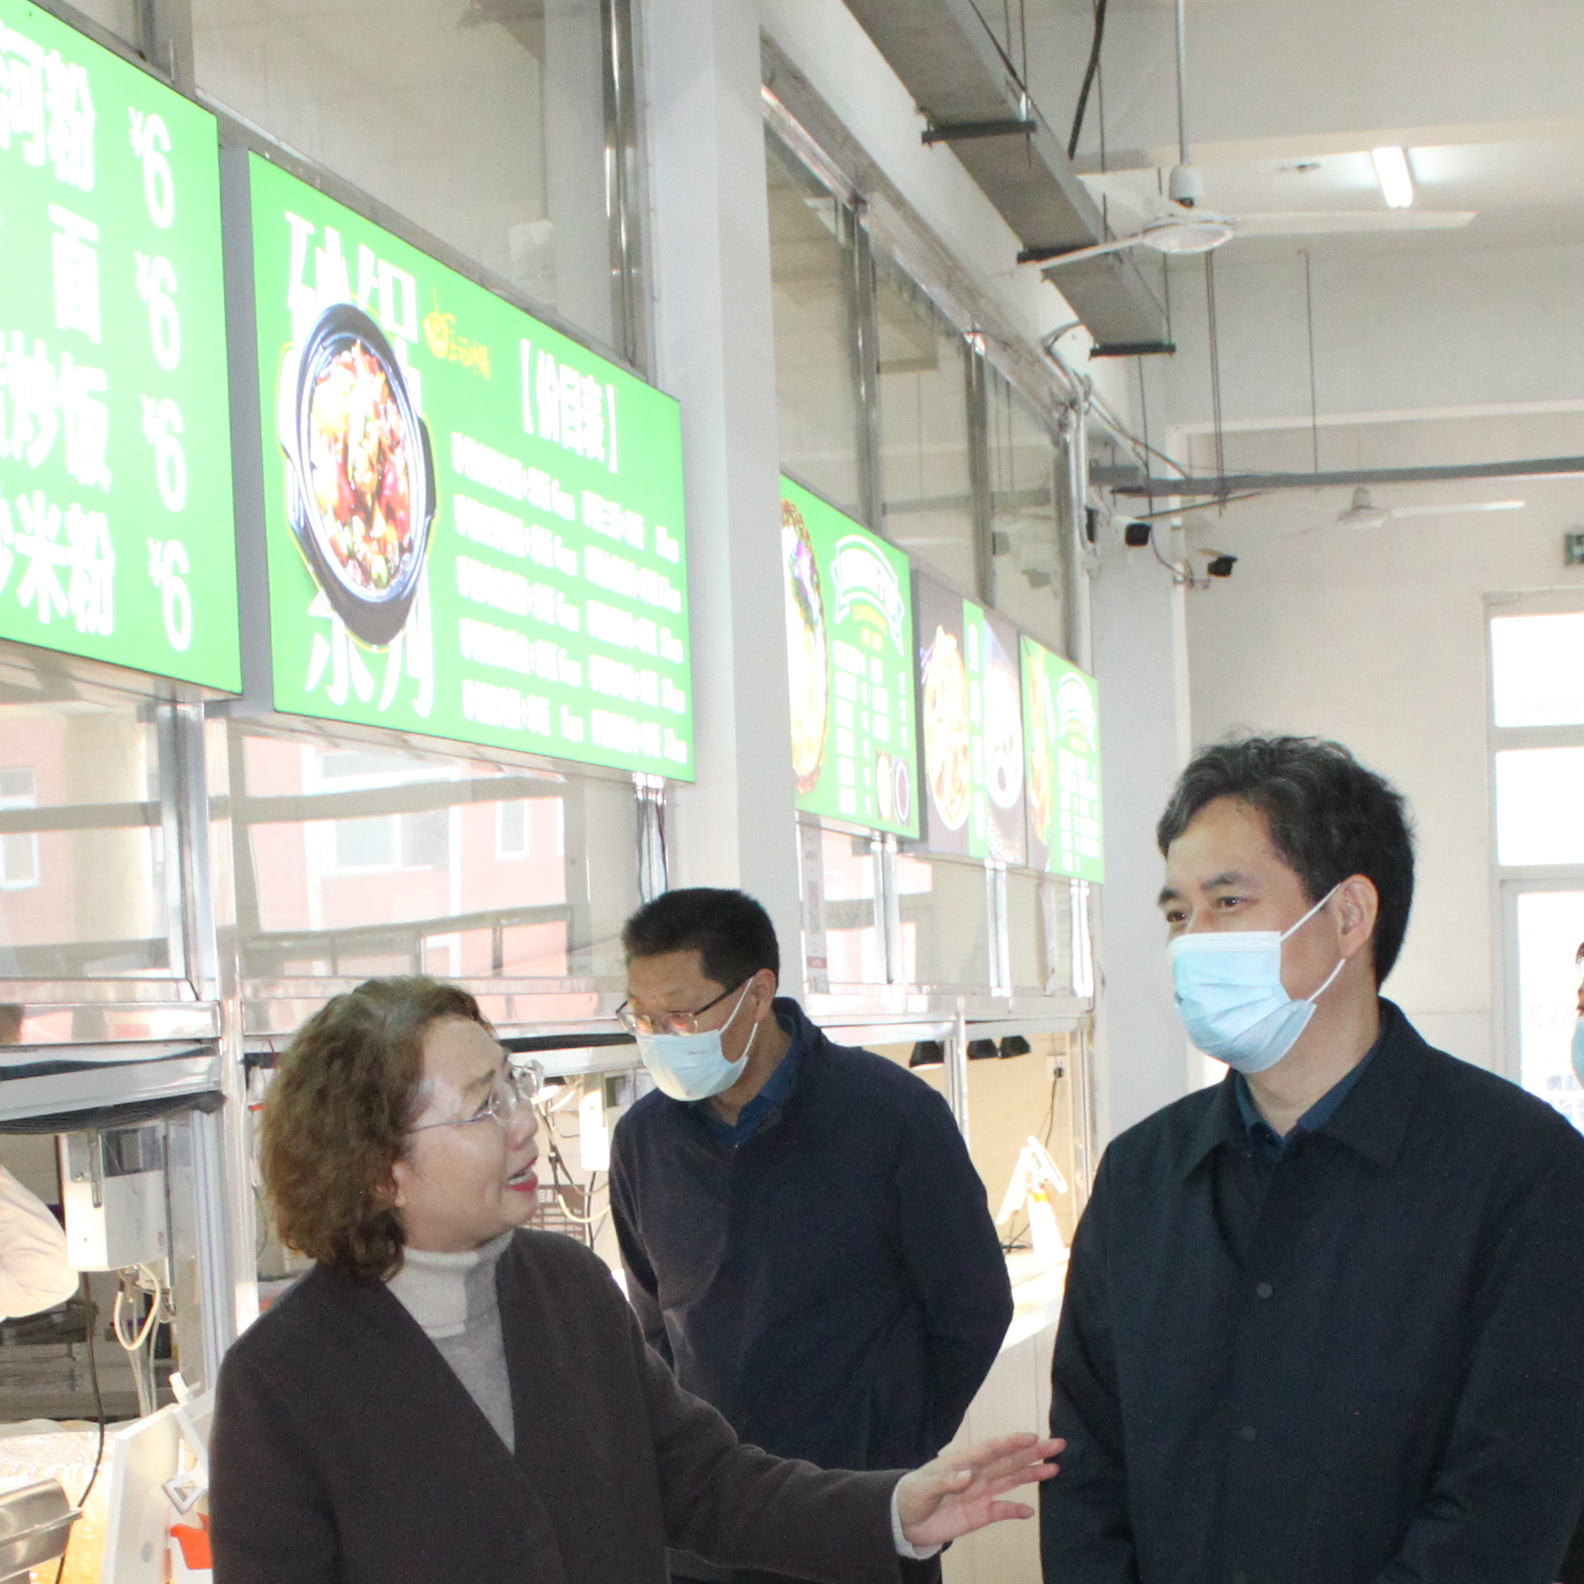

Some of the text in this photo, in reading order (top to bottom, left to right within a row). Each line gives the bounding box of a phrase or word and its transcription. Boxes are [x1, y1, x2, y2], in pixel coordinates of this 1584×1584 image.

[128, 106, 174, 229] ¥6
[134, 250, 181, 370] ¥6
[140, 394, 187, 511] ¥6
[148, 537, 193, 652] ¥6
